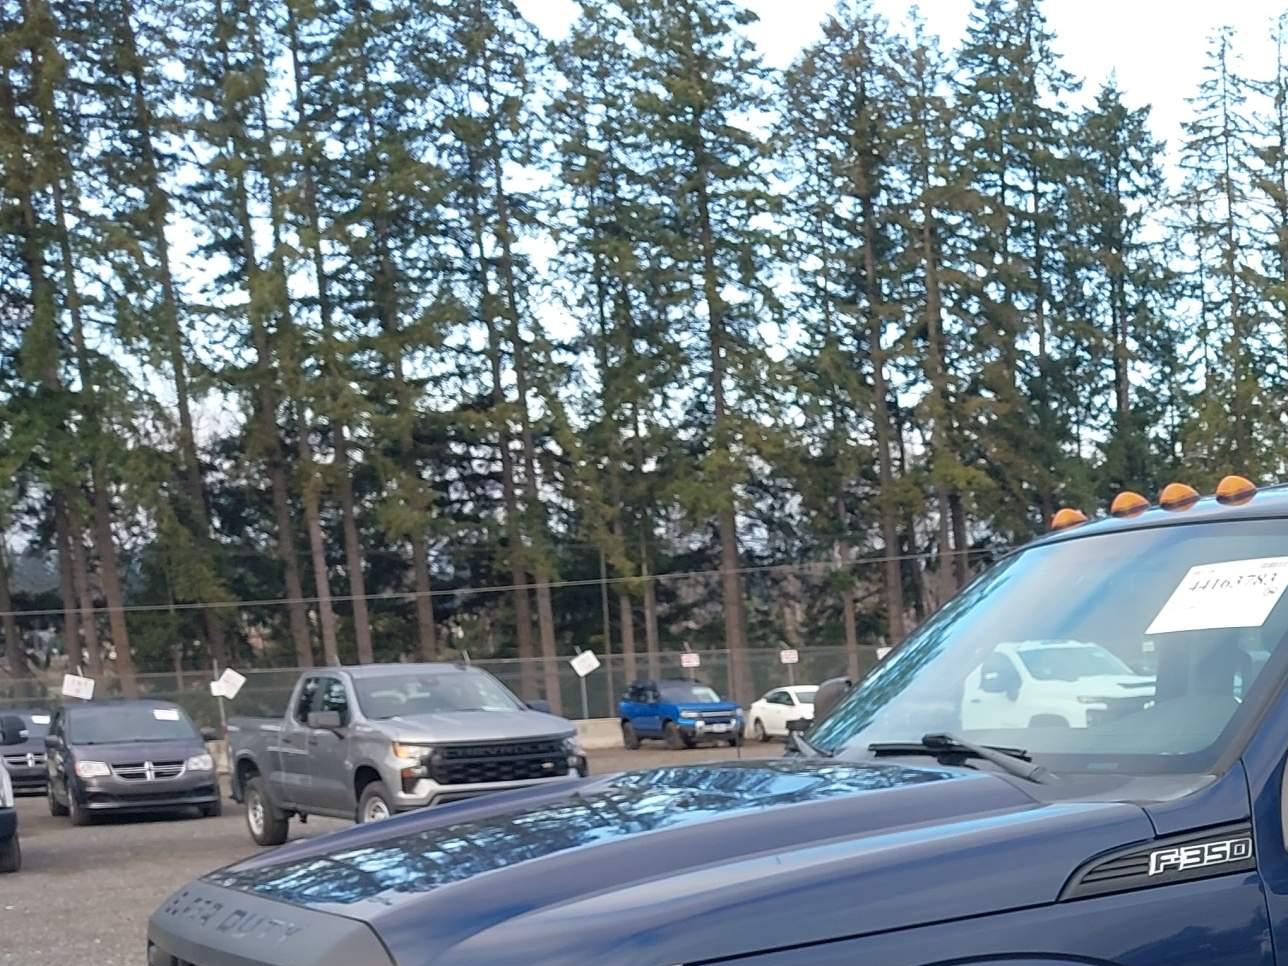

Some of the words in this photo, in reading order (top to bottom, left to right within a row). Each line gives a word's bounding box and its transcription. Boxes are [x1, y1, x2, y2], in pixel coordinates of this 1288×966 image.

[1188, 572, 1278, 592] 44163783
[1147, 837, 1253, 876] F-350
[216, 907, 303, 943] DUTY
